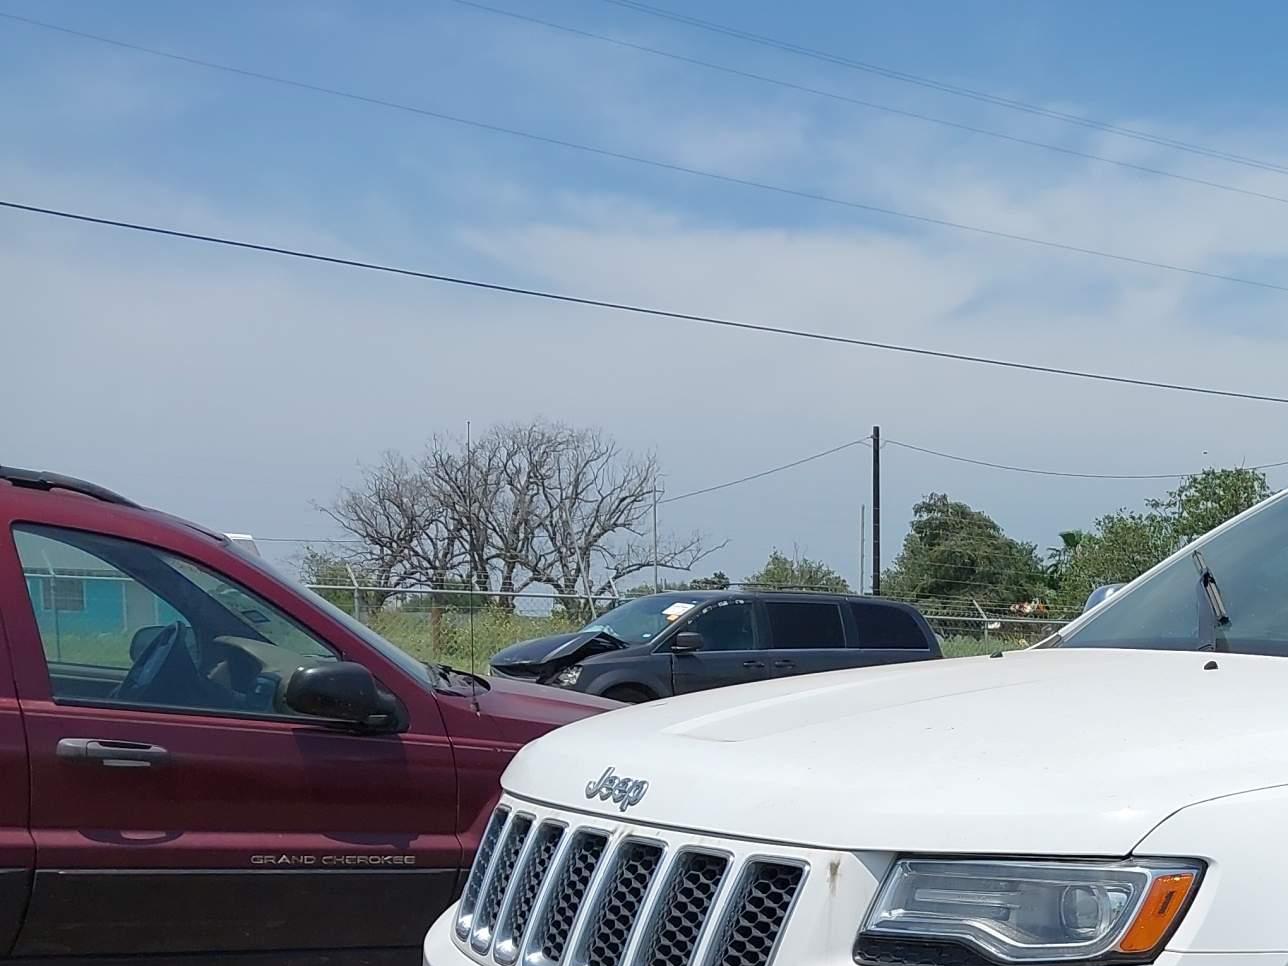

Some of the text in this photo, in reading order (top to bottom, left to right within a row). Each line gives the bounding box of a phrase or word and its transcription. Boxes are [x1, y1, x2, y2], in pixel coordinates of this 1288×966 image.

[585, 766, 649, 812] Jeep
[250, 855, 416, 865] GRAND CHEROKEE
